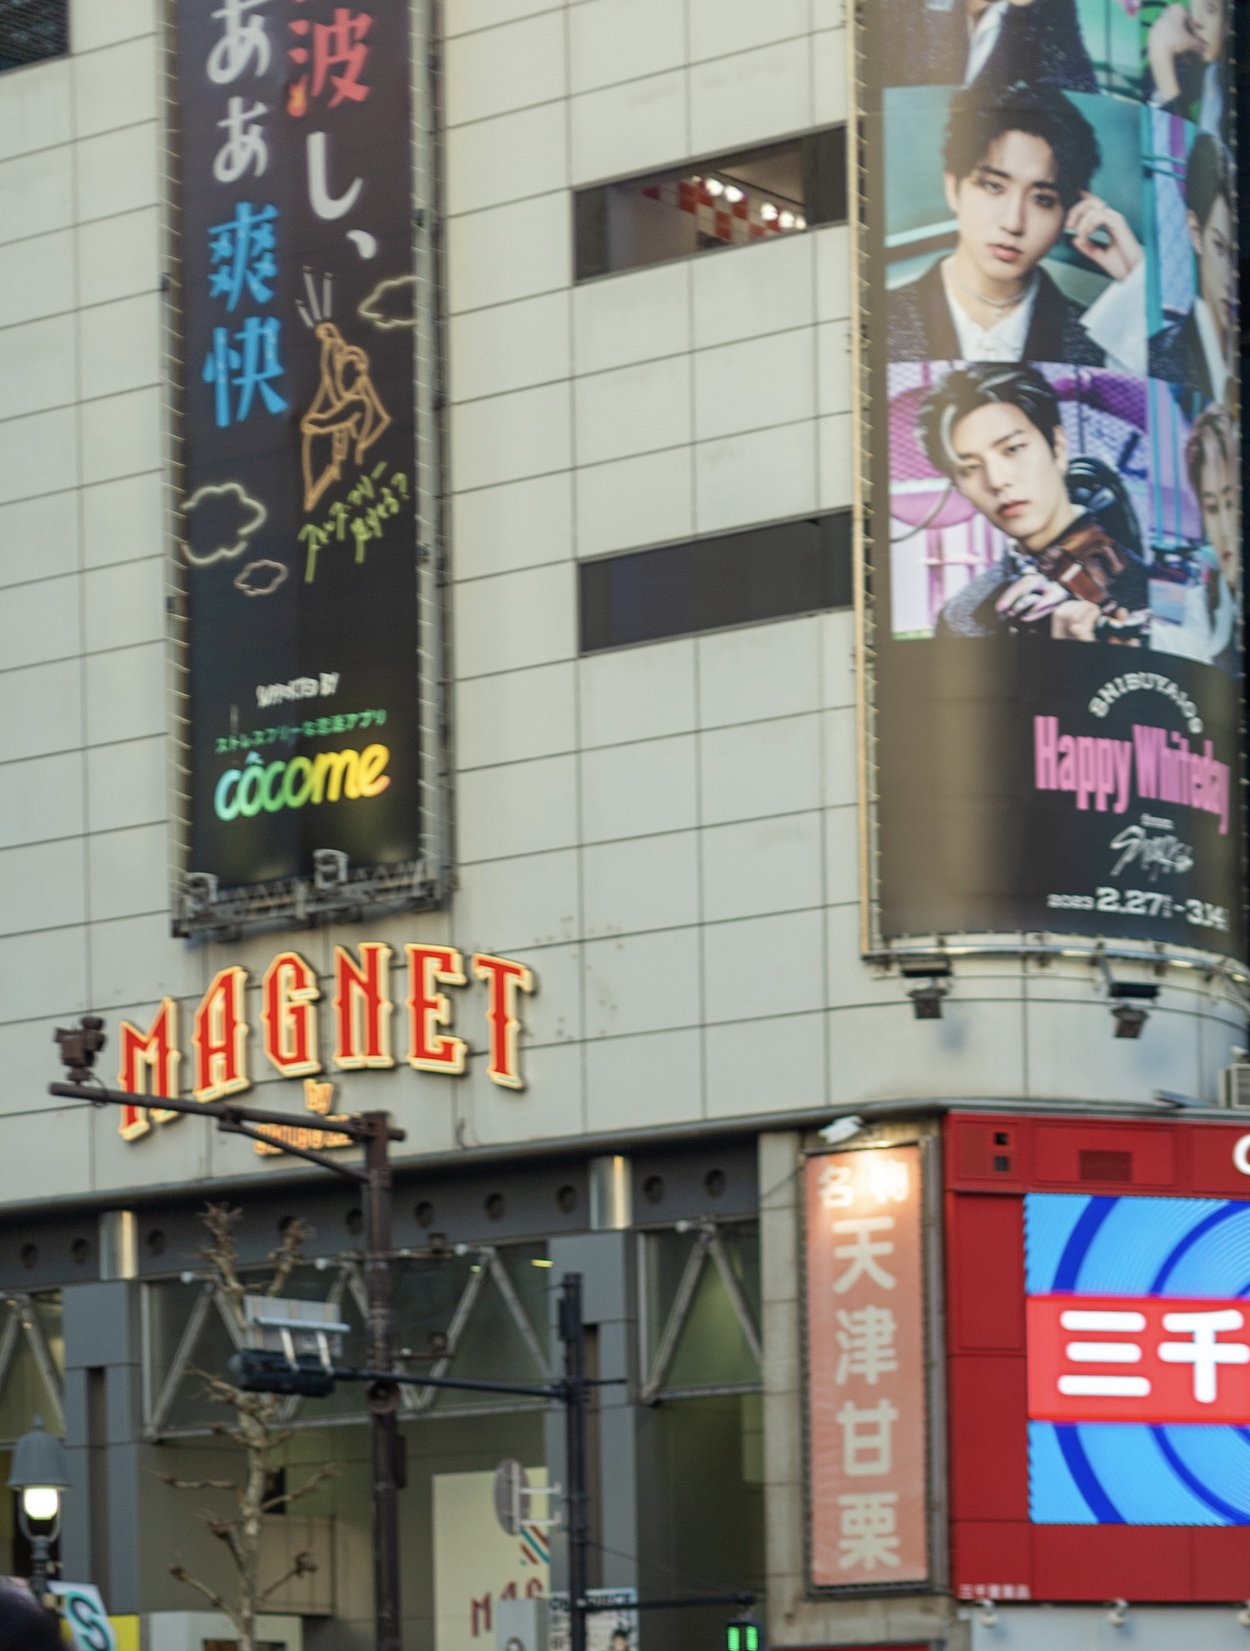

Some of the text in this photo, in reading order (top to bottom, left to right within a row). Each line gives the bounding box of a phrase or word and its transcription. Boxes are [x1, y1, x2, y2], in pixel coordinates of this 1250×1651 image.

[1033, 715, 1131, 815] Happy
[117, 941, 536, 1142] MAGNET
[831, 1215, 902, 1574] 天津甘栗
